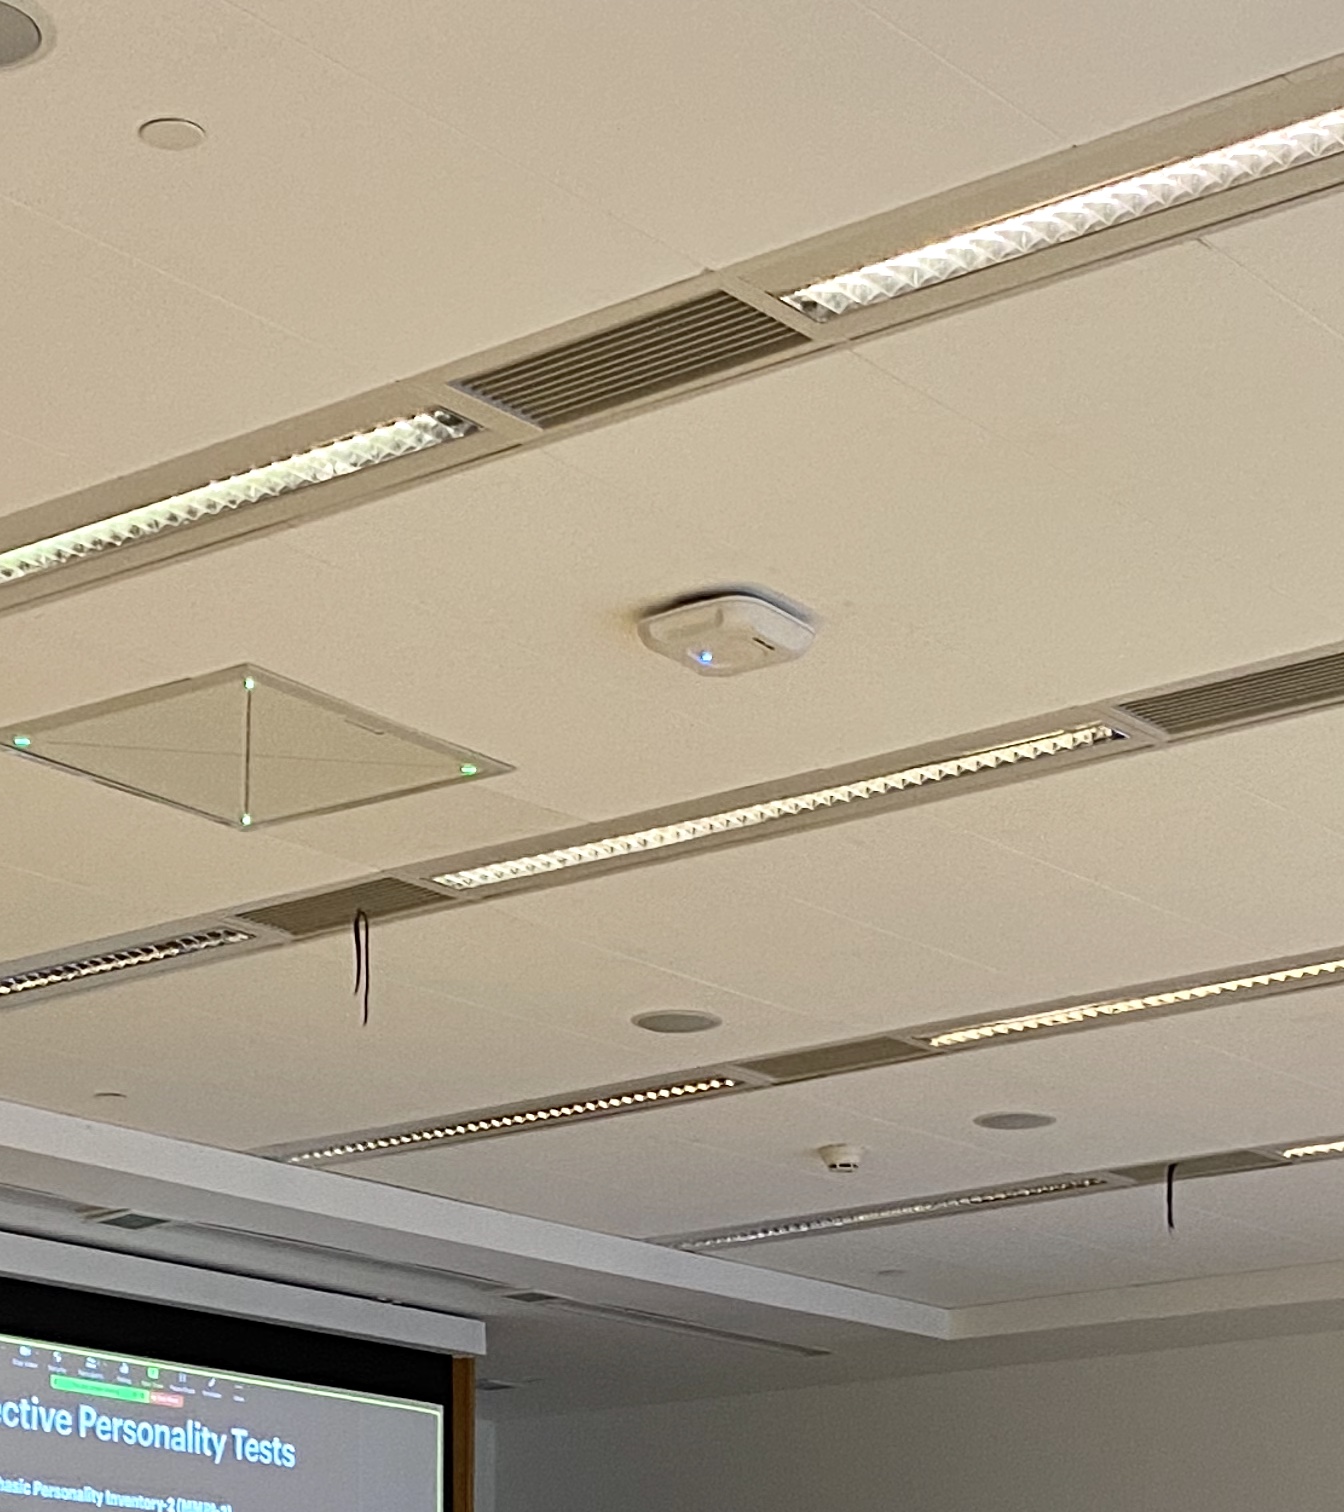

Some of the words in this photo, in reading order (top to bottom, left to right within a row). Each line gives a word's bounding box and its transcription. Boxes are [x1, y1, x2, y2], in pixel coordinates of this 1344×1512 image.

[78, 1404, 227, 1464] Personality
[231, 1427, 297, 1468] Tests
[32, 1480, 104, 1508] Personality
